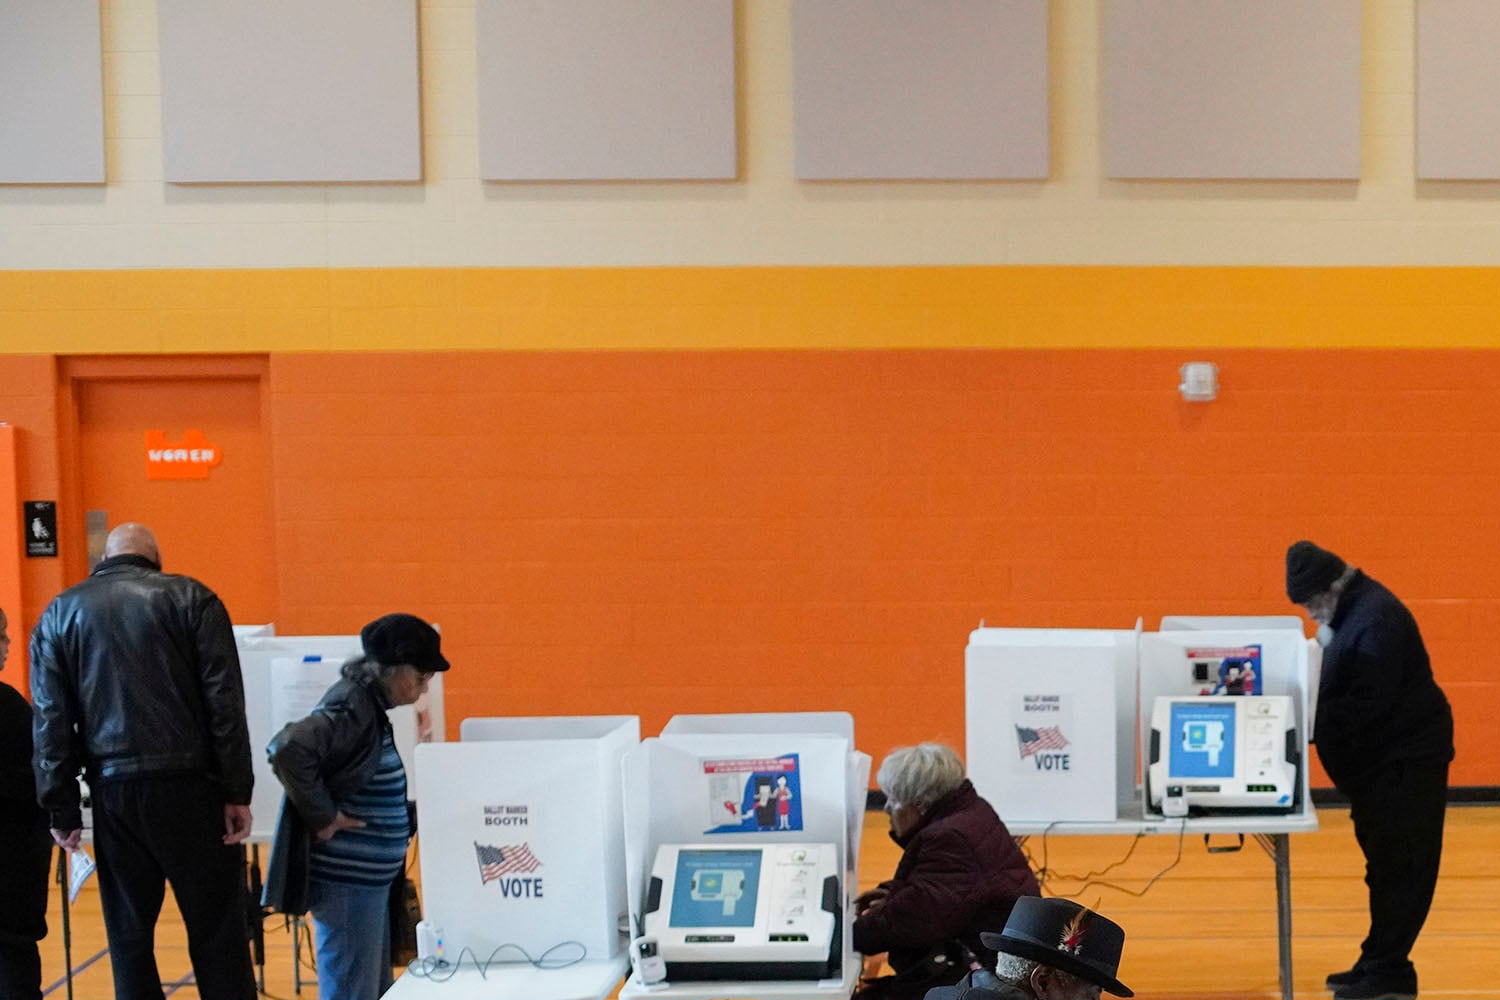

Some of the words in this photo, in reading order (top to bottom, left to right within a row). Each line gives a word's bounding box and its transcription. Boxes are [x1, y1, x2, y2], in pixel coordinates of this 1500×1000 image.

[148, 449, 214, 461] WOMEN
[1034, 754, 1070, 770] VOTE
[484, 816, 528, 826] BOOTH
[499, 878, 543, 898] VOTE
